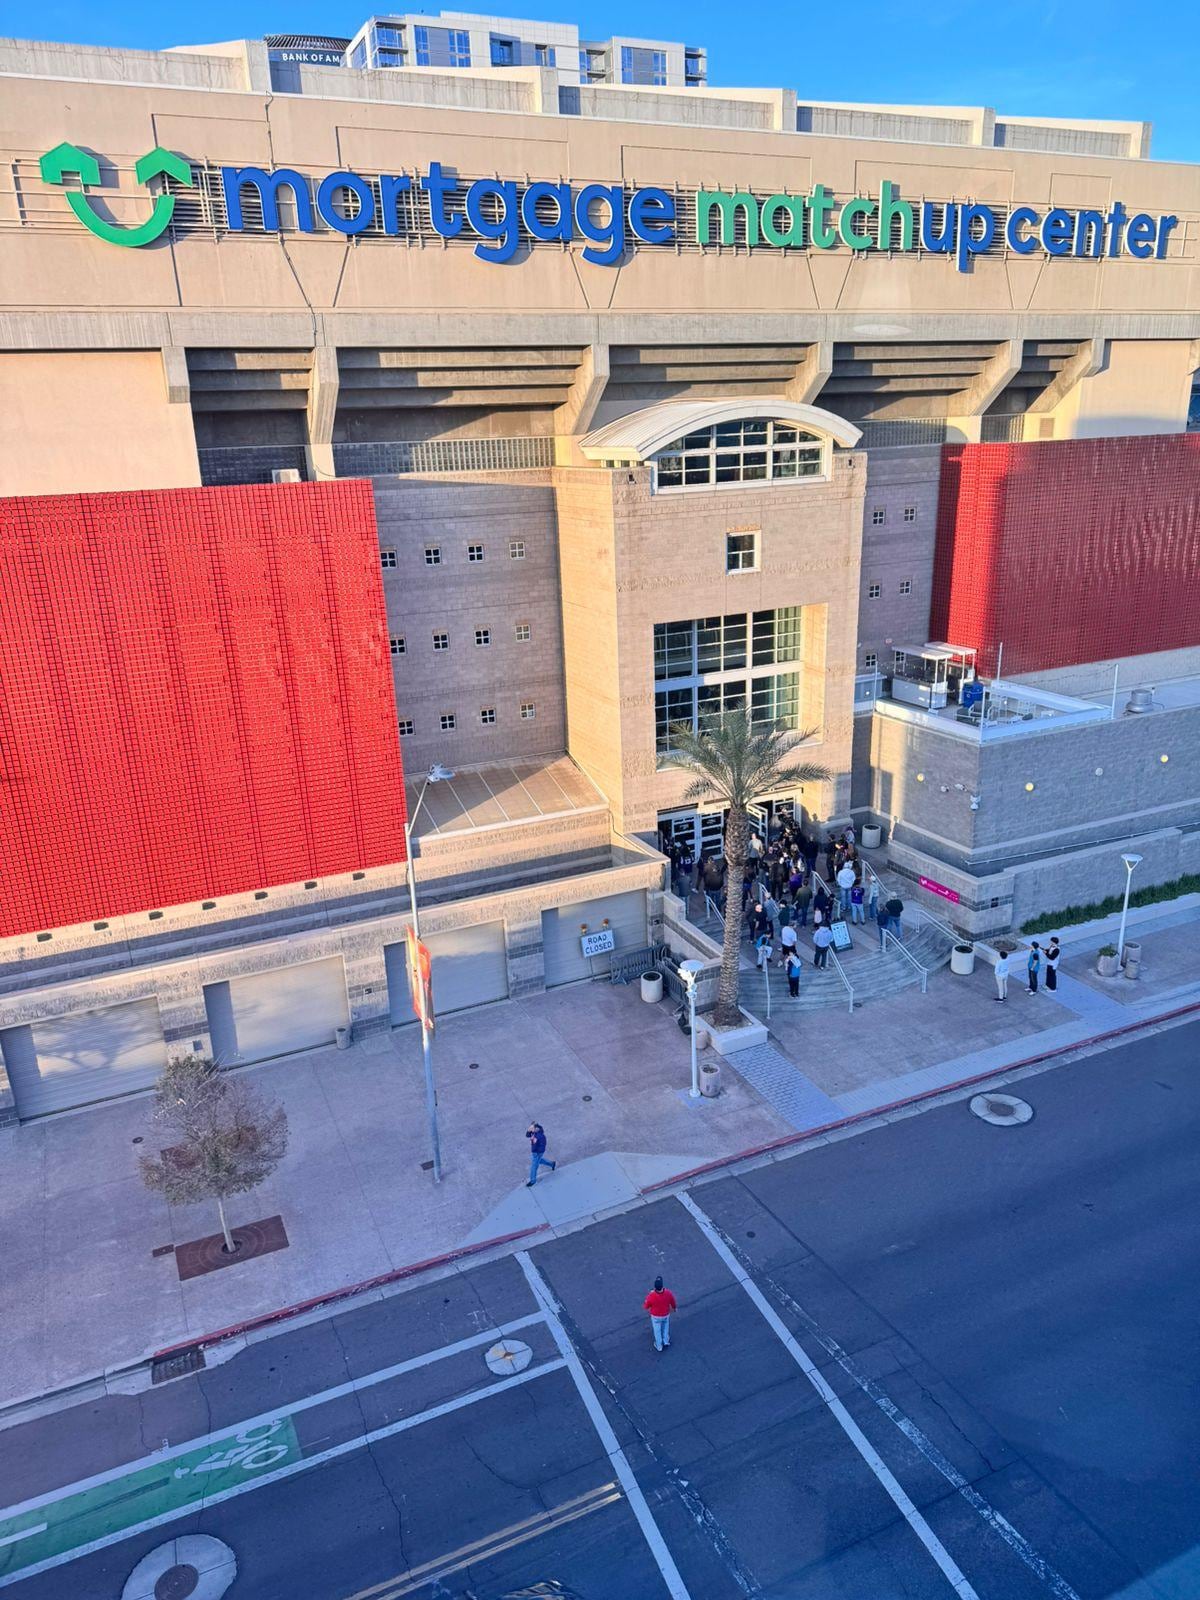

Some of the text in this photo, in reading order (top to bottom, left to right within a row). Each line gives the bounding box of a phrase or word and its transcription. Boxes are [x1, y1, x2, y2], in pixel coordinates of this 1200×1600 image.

[282, 53, 309, 62] BANK
[311, 54, 324, 62] OF
[221, 162, 676, 264] mortgage
[1005, 201, 1178, 259] center
[587, 934, 608, 945] ROAD
[585, 941, 613, 954] CLOSED
